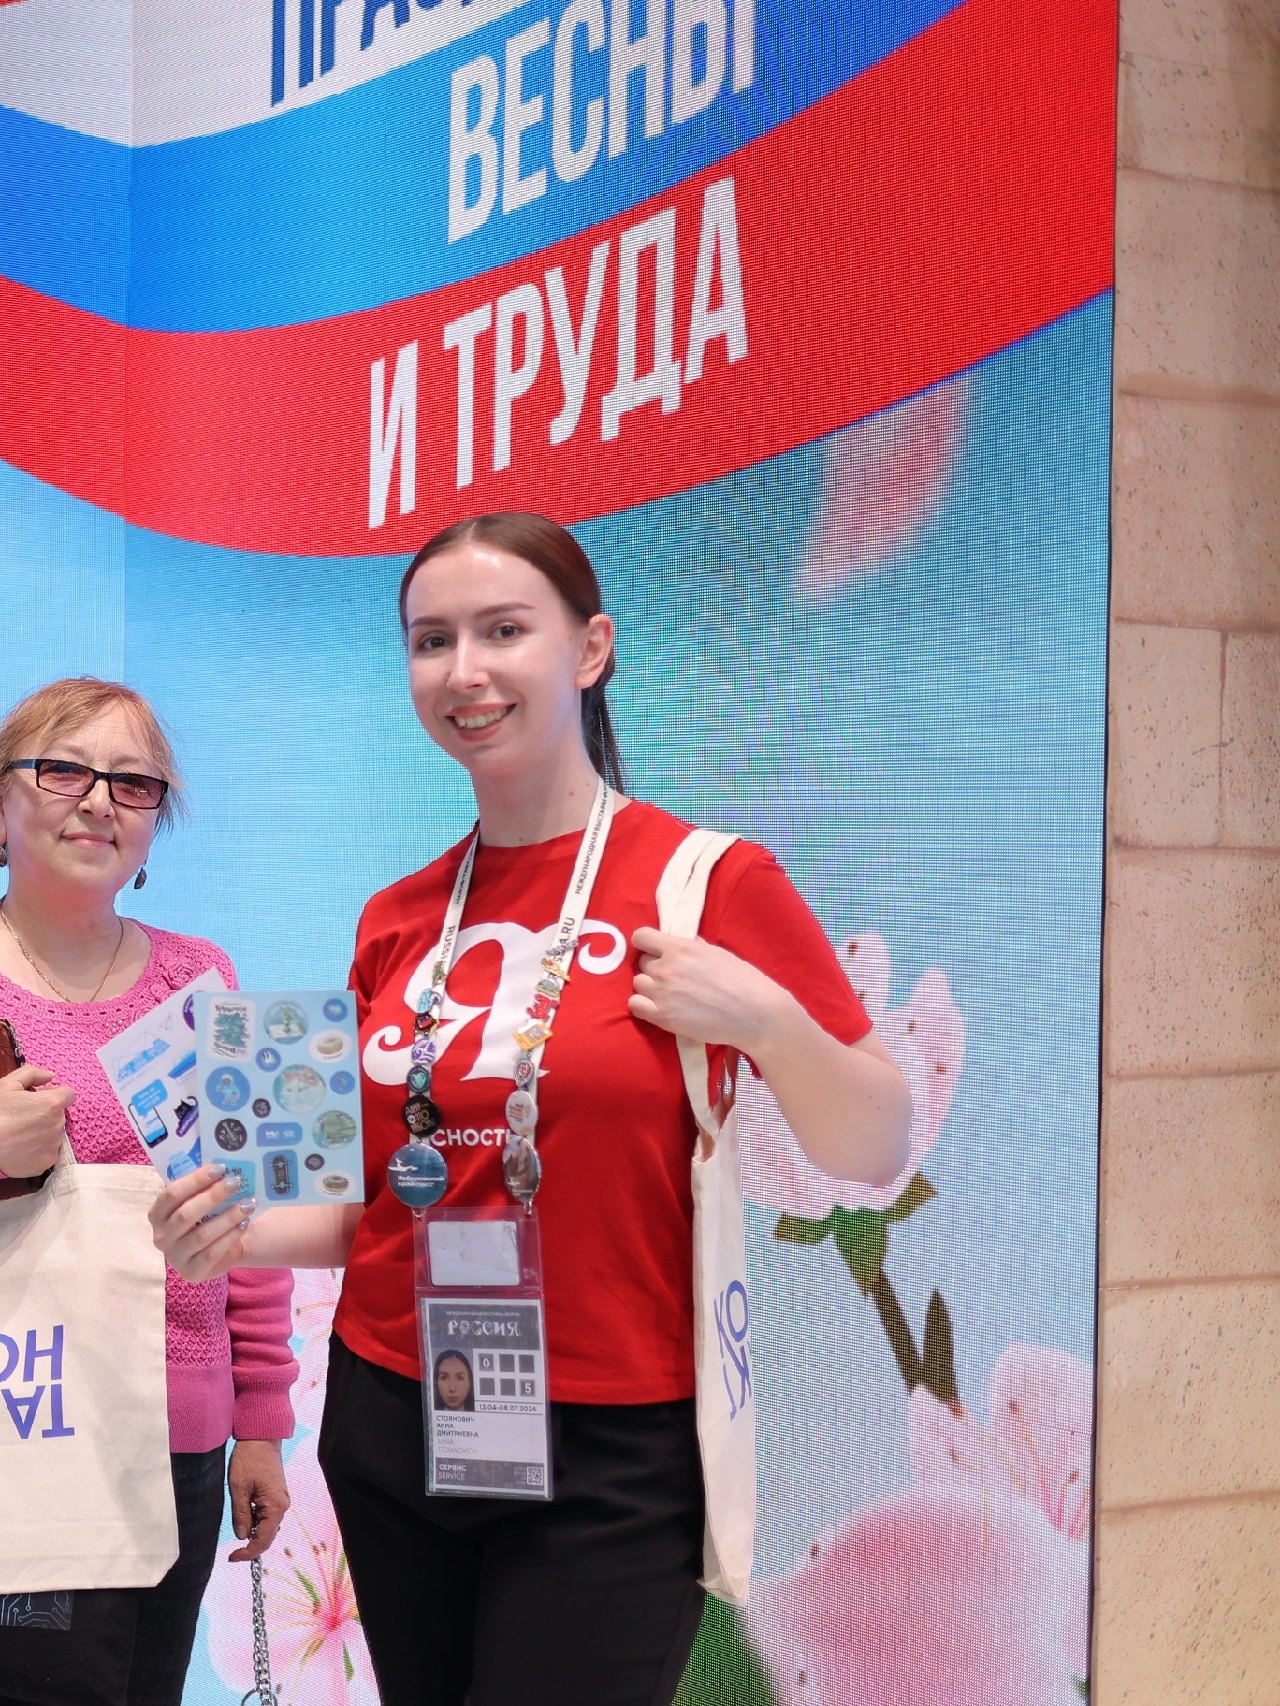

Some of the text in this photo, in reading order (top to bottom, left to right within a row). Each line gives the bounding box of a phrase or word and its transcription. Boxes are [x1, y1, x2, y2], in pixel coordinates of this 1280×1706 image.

[448, 0, 756, 244] ВЕСНЫ
[368, 176, 748, 529] И ТРУДА
[448, 1319, 520, 1337] РОССИЯ
[482, 1358, 490, 1368] 0
[524, 1382, 532, 1394] 5
[438, 1463, 467, 1472] СЕРВИС
[438, 1472, 466, 1481] SERVICE
